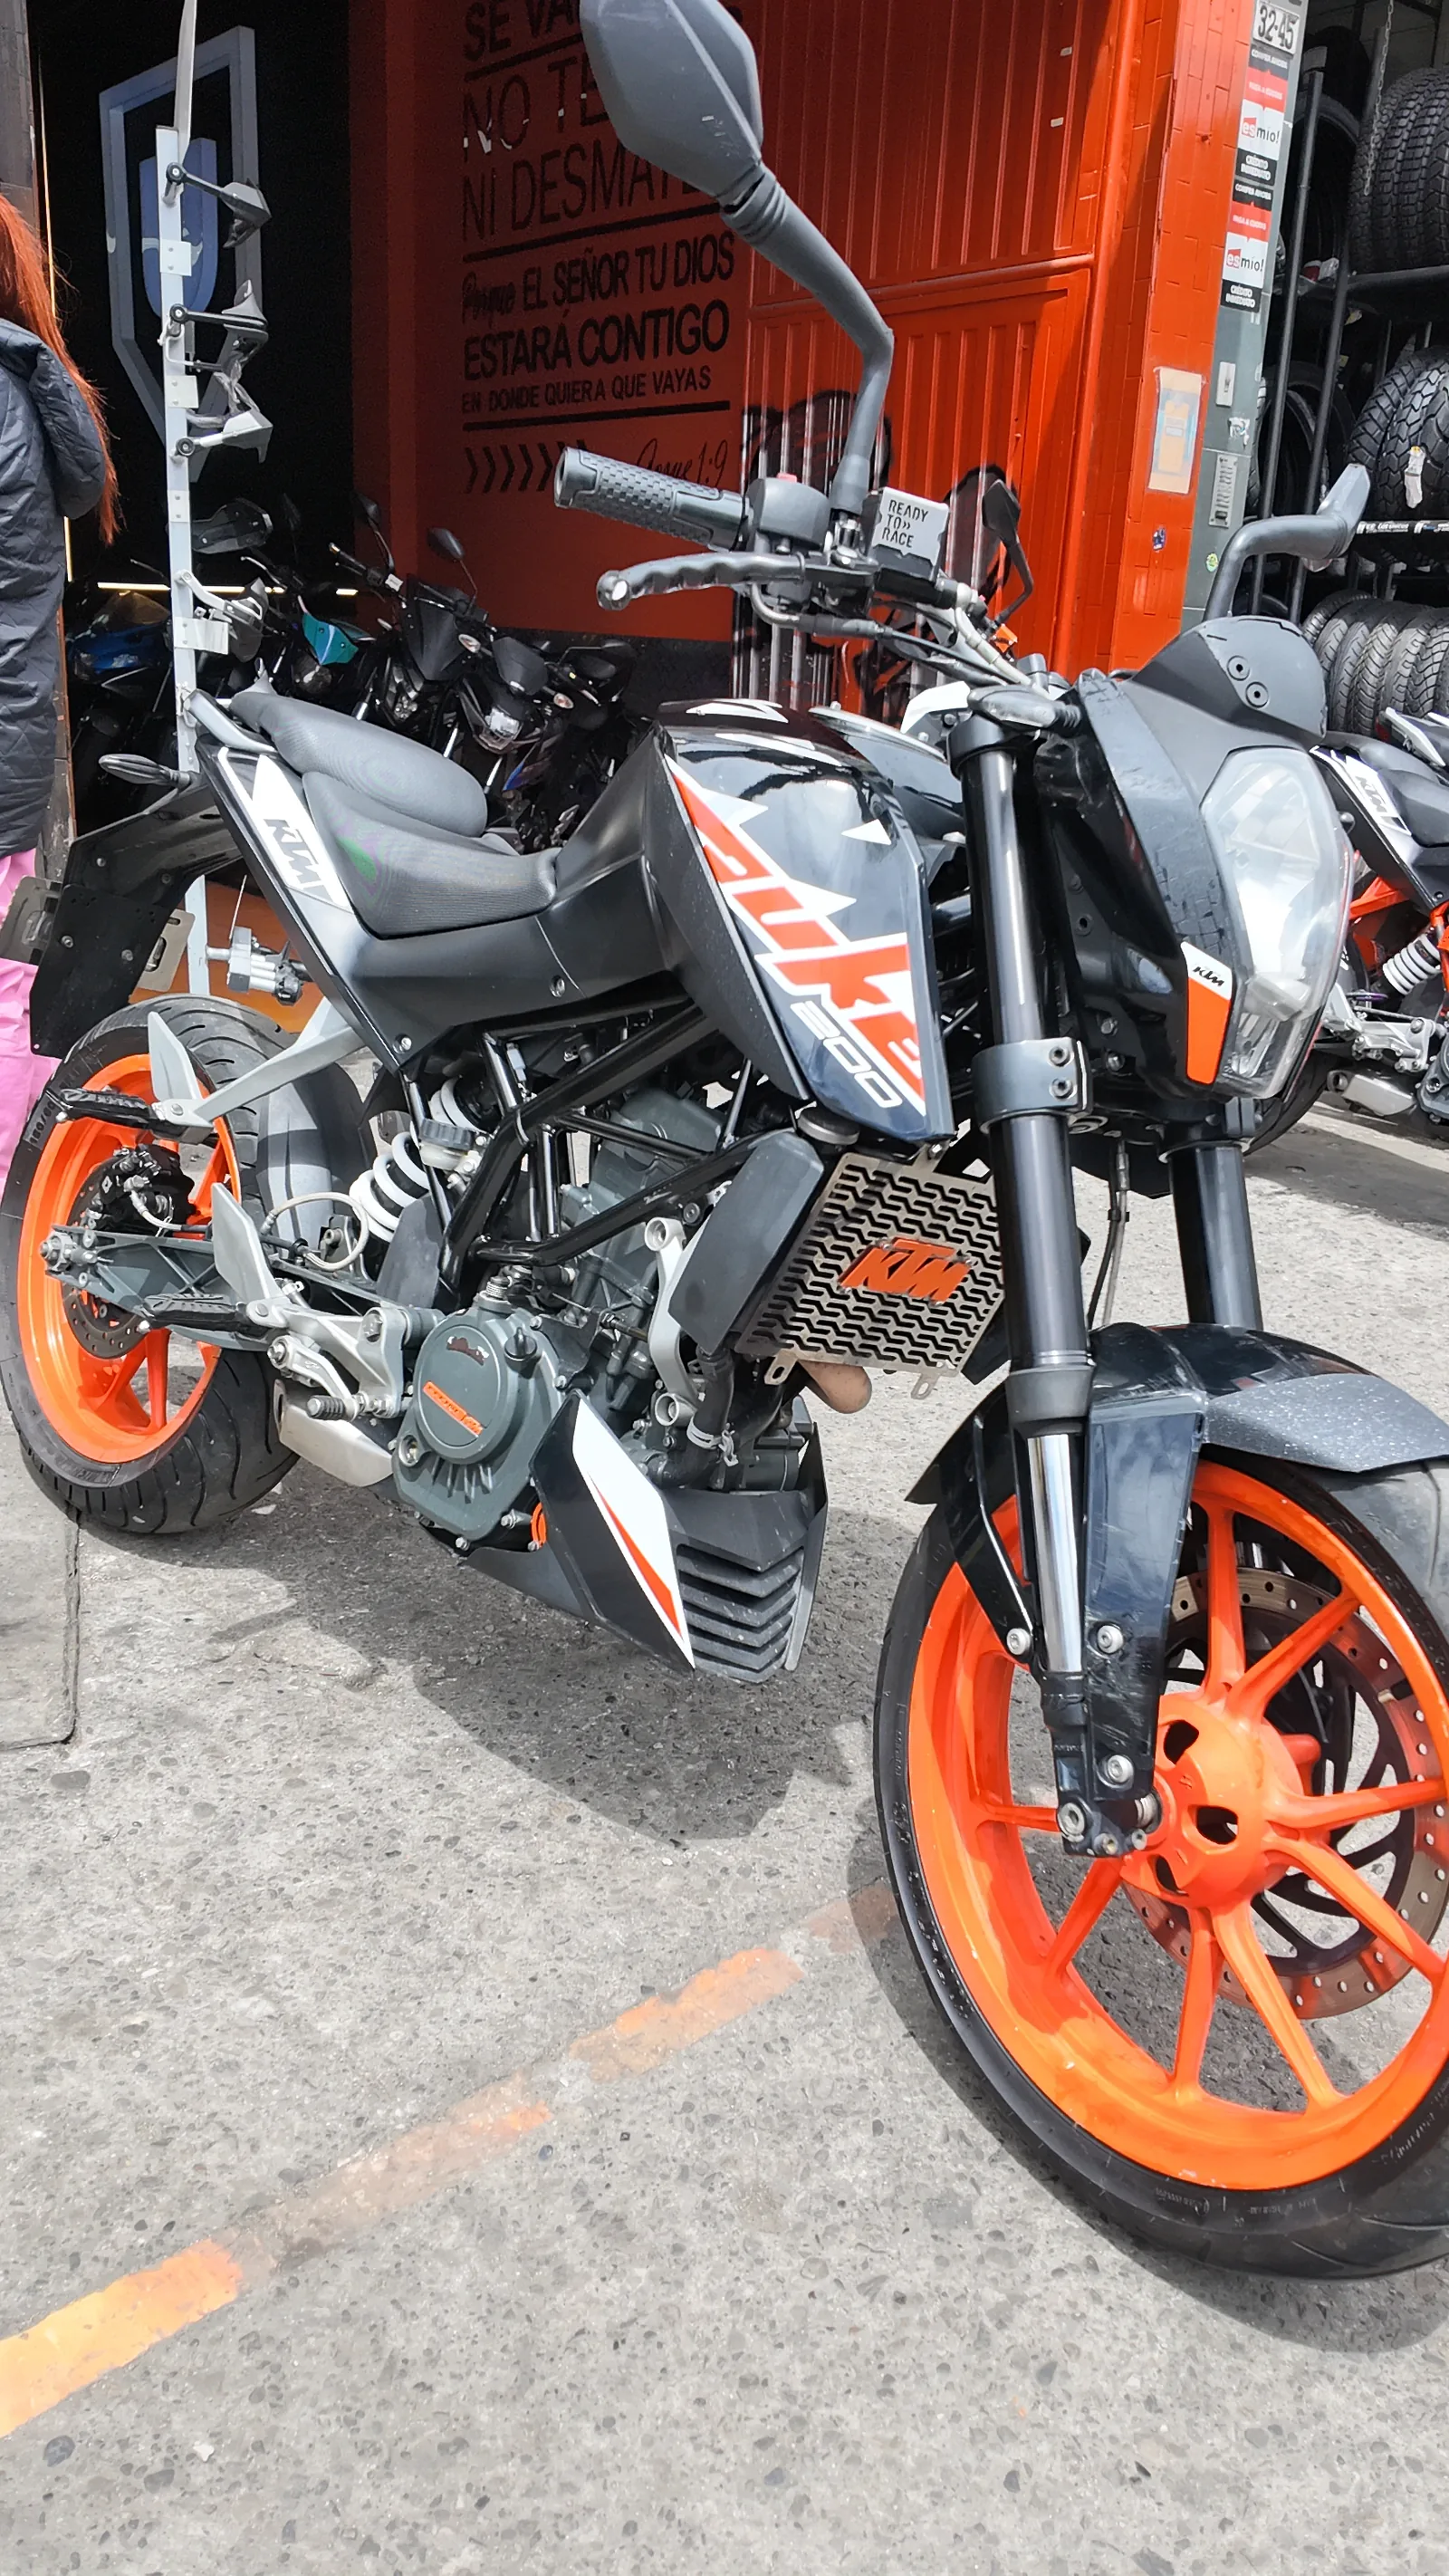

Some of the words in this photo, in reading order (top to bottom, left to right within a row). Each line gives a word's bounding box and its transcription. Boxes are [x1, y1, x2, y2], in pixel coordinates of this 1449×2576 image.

[1257, 5, 1294, 50] 32-45
[463, 75, 531, 163] NO
[462, 168, 495, 241] NI
[523, 266, 547, 311] EL
[553, 246, 629, 306] SEÑOR
[636, 242, 667, 293] TU
[674, 231, 735, 287] DIOS
[464, 309, 572, 381] ESTARÁ
[578, 299, 730, 367] CONTIGO
[462, 392, 481, 414] EN
[489, 385, 539, 412] DONDE
[544, 379, 606, 407] QUIERA
[612, 372, 647, 400] QUE
[652, 365, 712, 395] VAYAS
[882, 527, 914, 548] RACE
[888, 499, 928, 522] READY
[263, 819, 322, 885] KTM
[1193, 966, 1224, 986] KTM
[791, 1001, 903, 1108] 200
[839, 1237, 973, 1304] KTM
